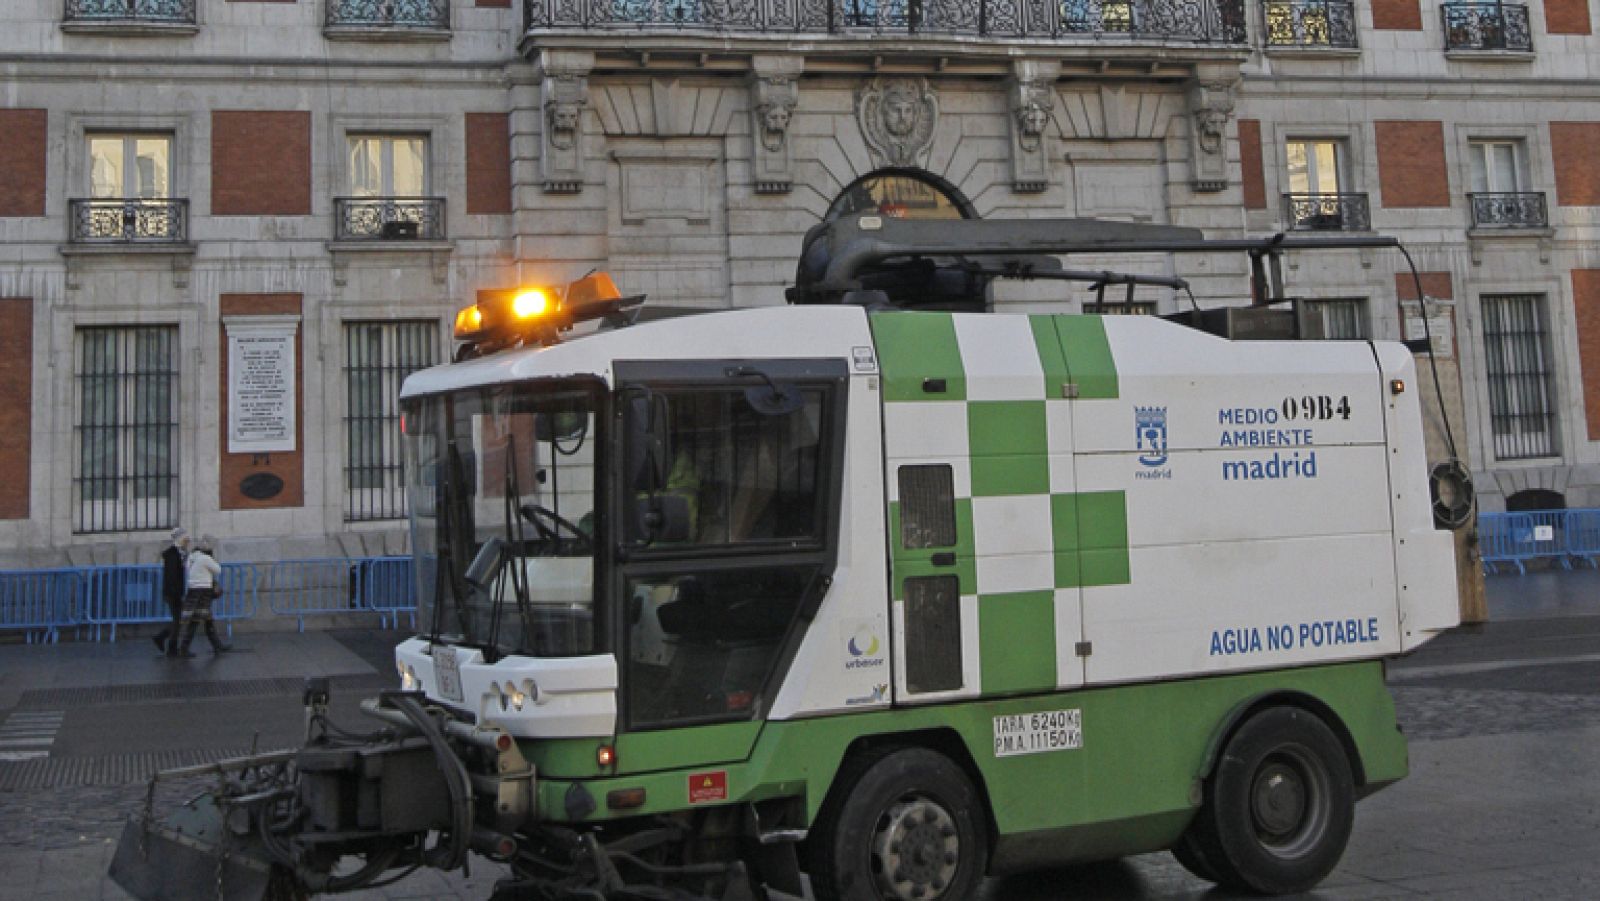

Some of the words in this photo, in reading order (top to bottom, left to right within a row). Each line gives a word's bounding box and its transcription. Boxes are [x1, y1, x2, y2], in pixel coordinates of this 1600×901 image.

[1218, 408, 1278, 425] MEDIO
[1282, 395, 1351, 421] 09B4
[1220, 429, 1313, 447] AMBIENTE
[1135, 467, 1172, 480] madrid
[1222, 452, 1317, 480] madrid
[1210, 626, 1262, 655] AGUA
[1267, 624, 1294, 650] NO
[1300, 616, 1379, 648] POTABLE
